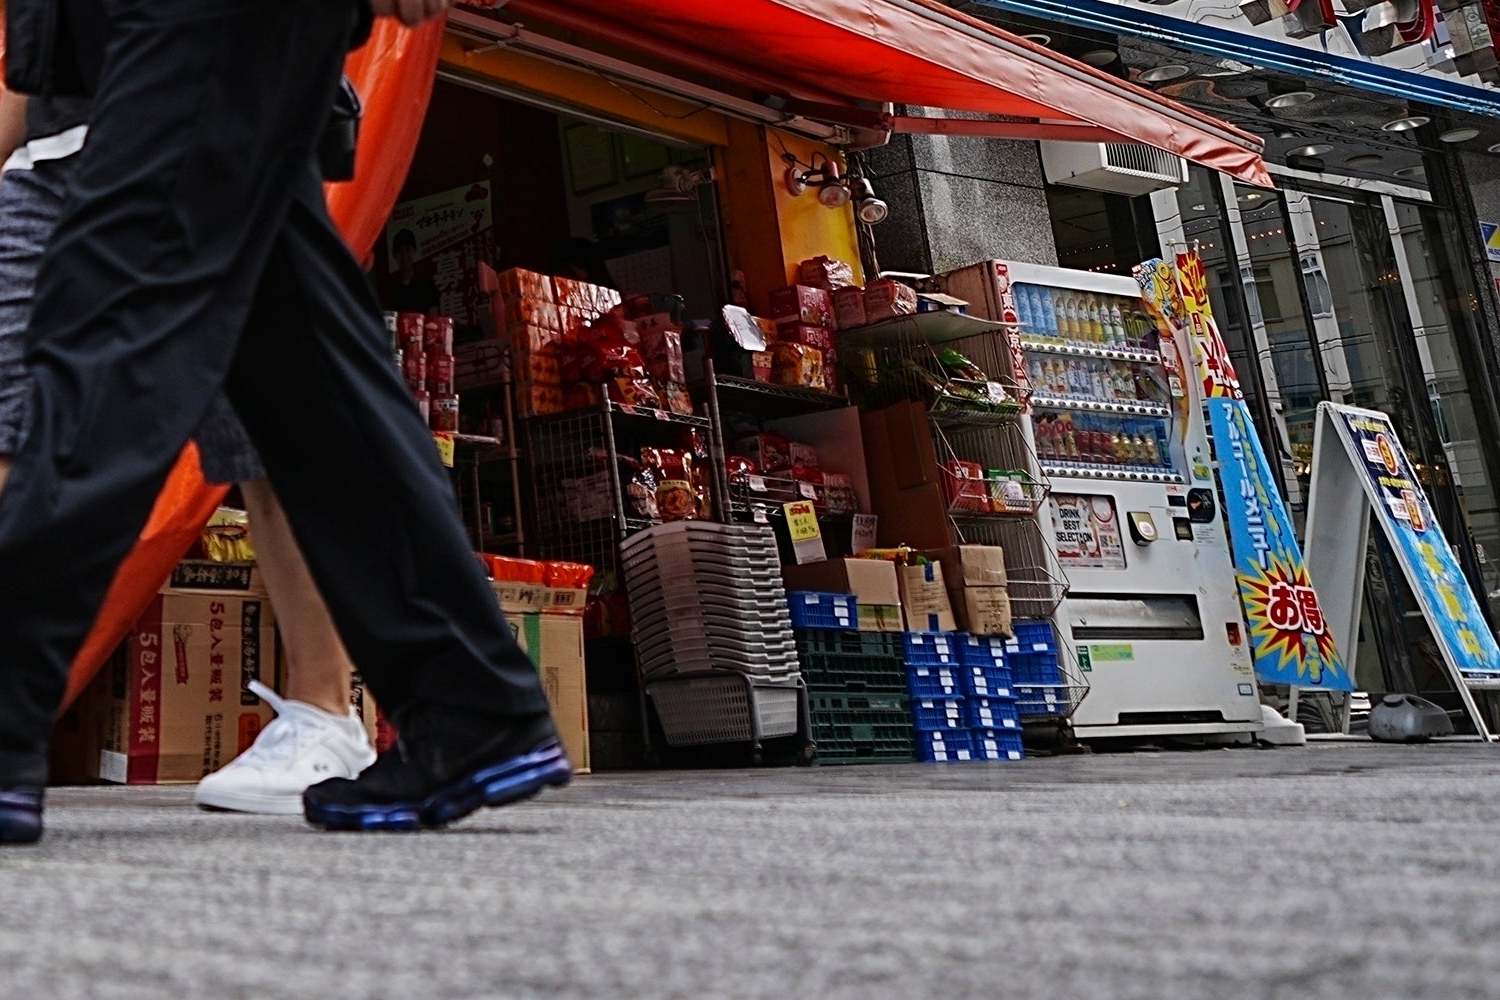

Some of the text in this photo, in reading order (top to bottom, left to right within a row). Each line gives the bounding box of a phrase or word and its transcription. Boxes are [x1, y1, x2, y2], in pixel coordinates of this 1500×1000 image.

[1059, 508, 1080, 519] DRINK
[1063, 520, 1080, 531] BEST
[1267, 581, 1326, 636] お得
